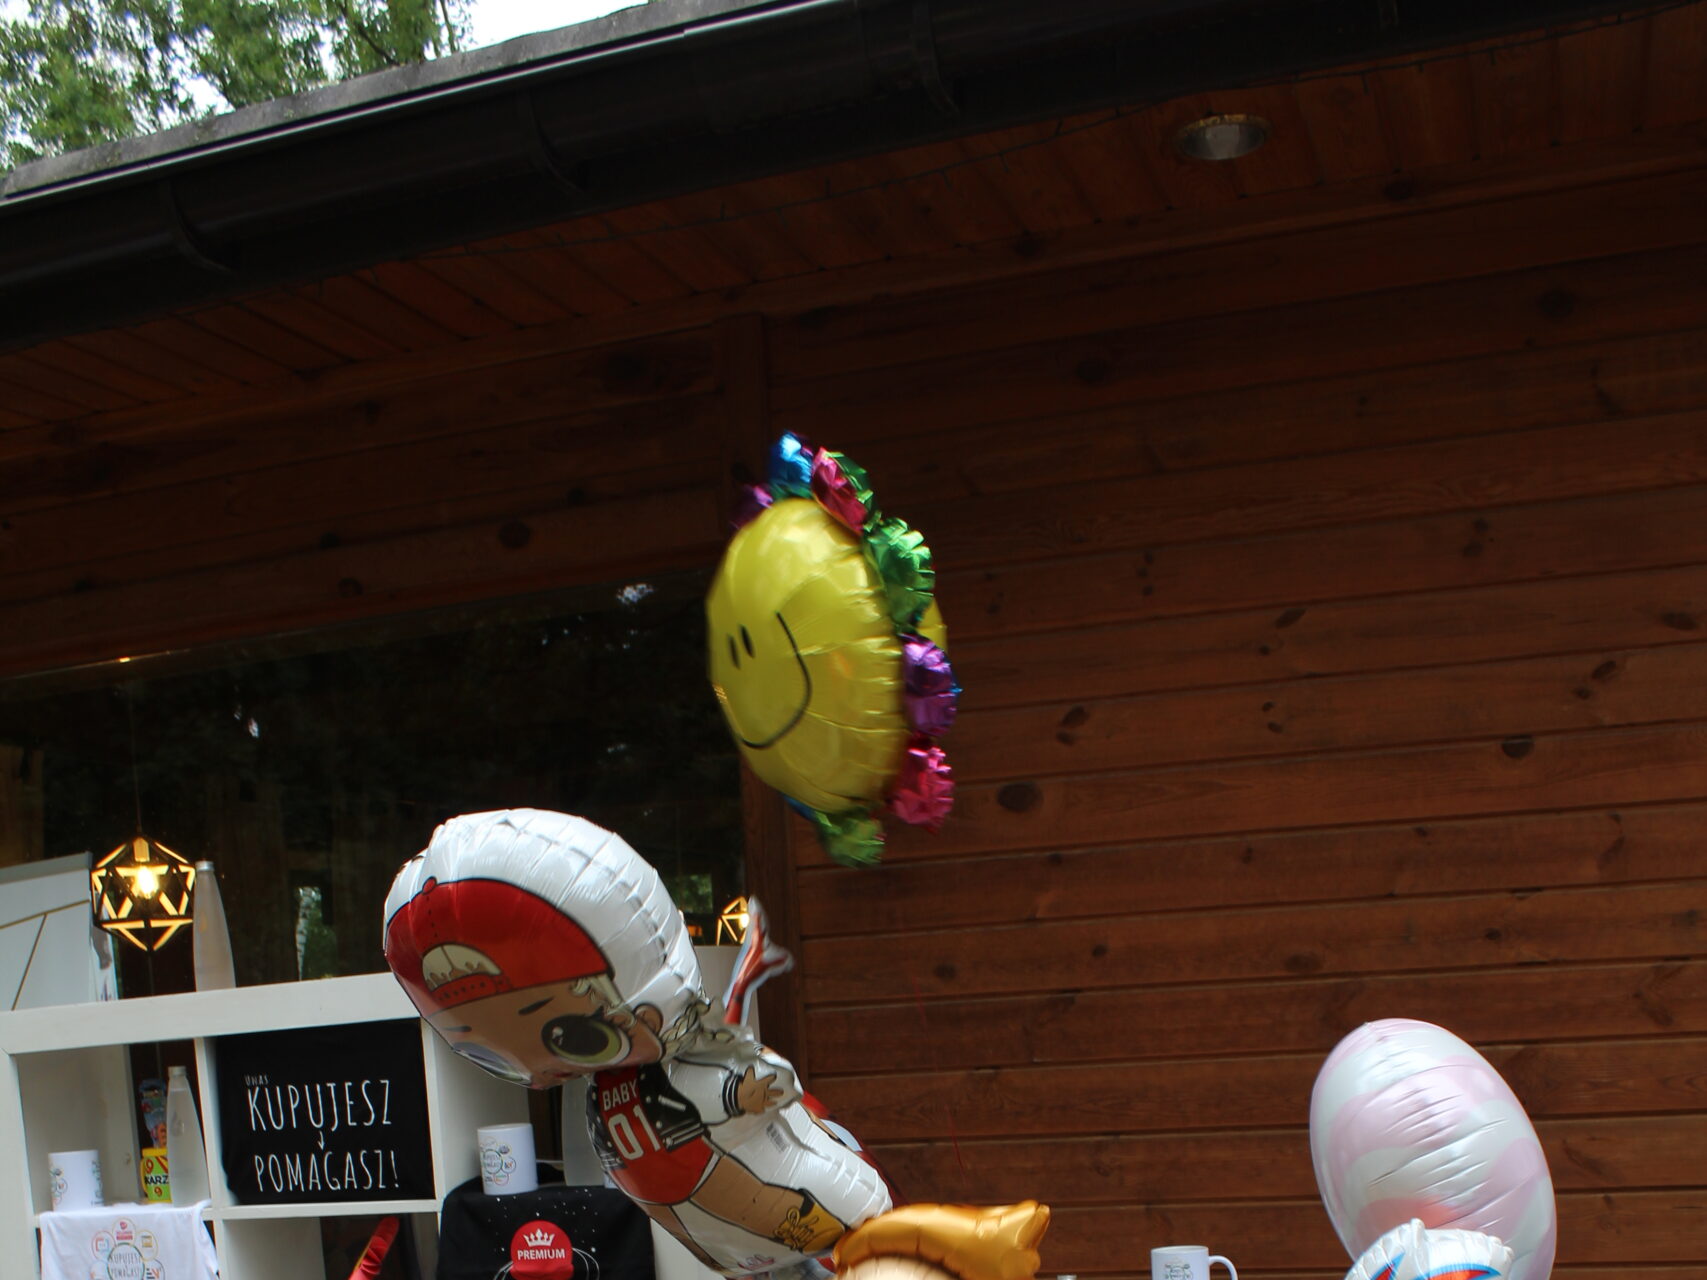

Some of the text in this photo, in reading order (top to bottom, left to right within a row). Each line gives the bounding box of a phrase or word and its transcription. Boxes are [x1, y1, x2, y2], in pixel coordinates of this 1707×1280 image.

[247, 1079, 392, 1132] KUPUJESZ
[602, 1079, 638, 1112] BABY
[608, 1103, 661, 1160] 01
[254, 1149, 399, 1193] POMAGASZ!
[517, 1248, 566, 1260] PREMIUM
